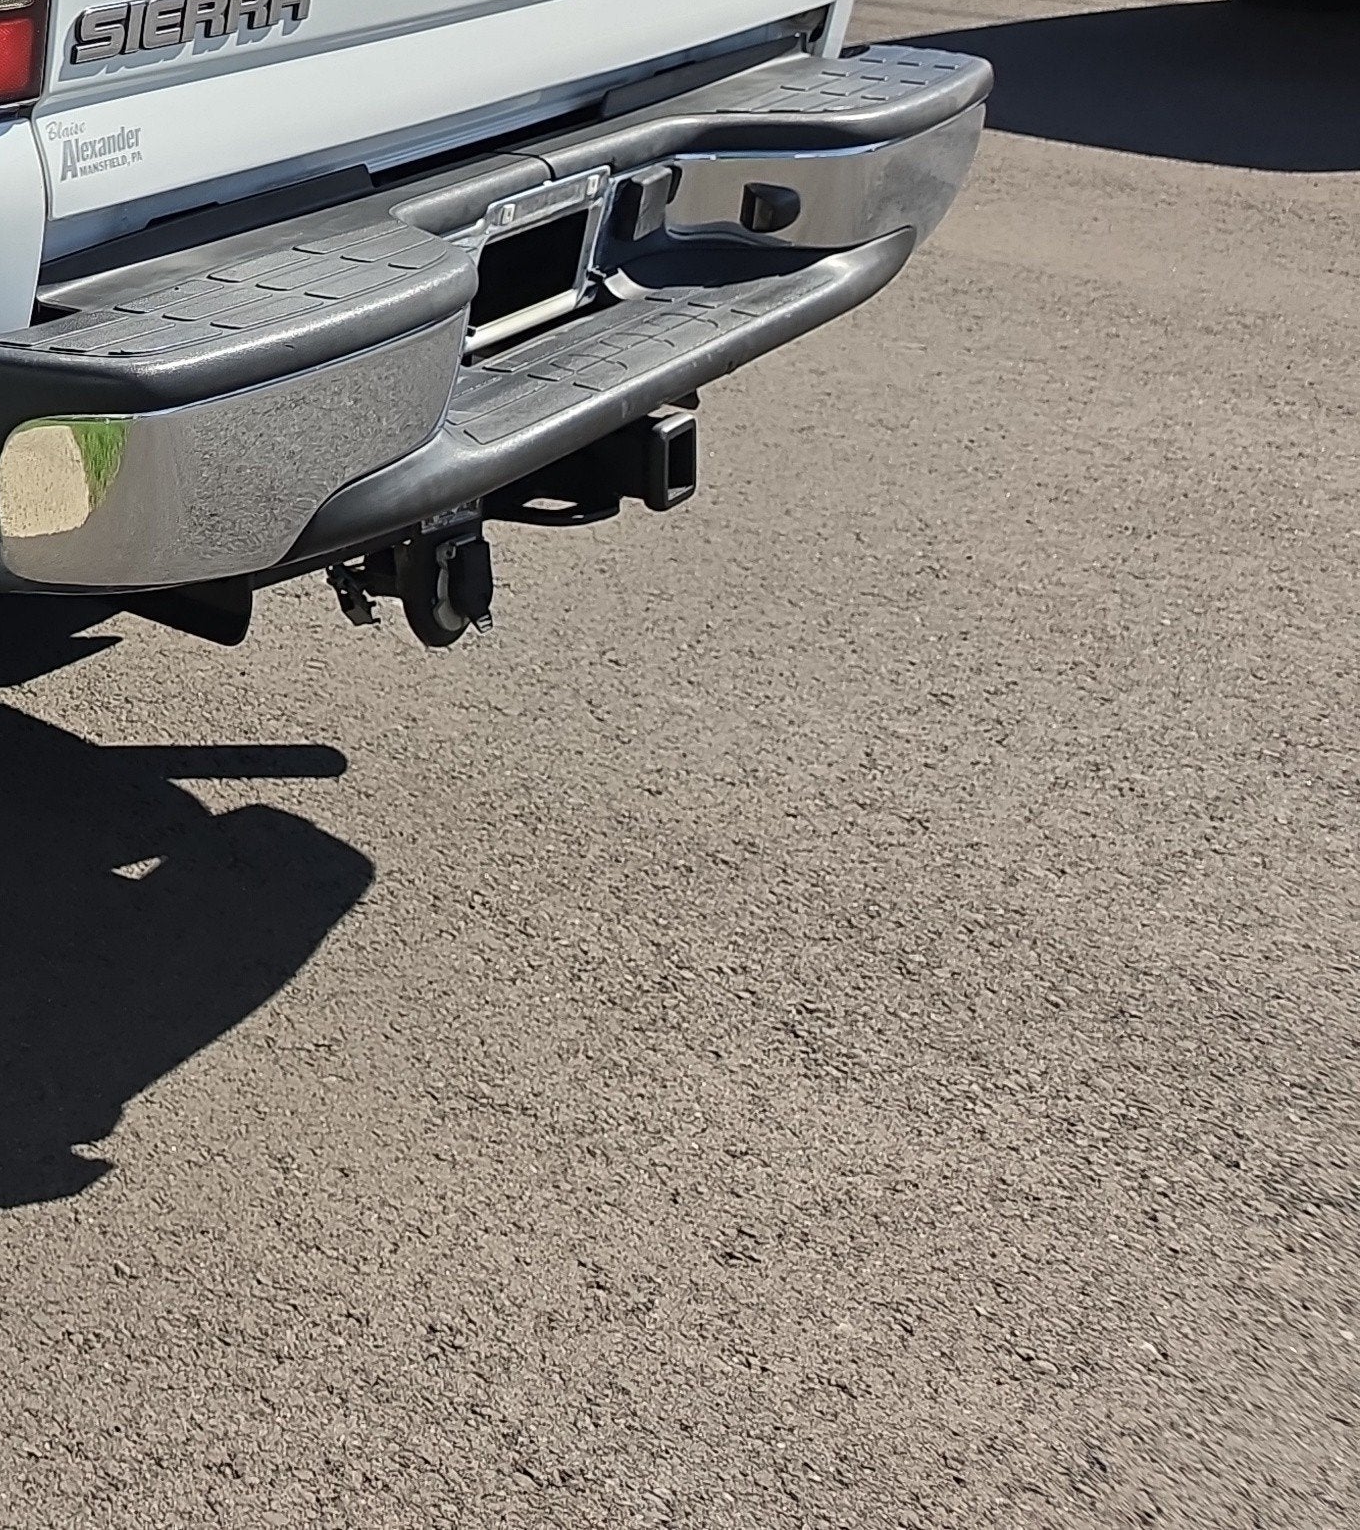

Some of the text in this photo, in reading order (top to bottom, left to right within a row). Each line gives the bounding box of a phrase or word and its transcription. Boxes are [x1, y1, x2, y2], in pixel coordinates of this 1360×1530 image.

[45, 120, 87, 141] Blaise
[60, 126, 142, 181] Alexander
[79, 150, 143, 177] MANSFIELD, PA
